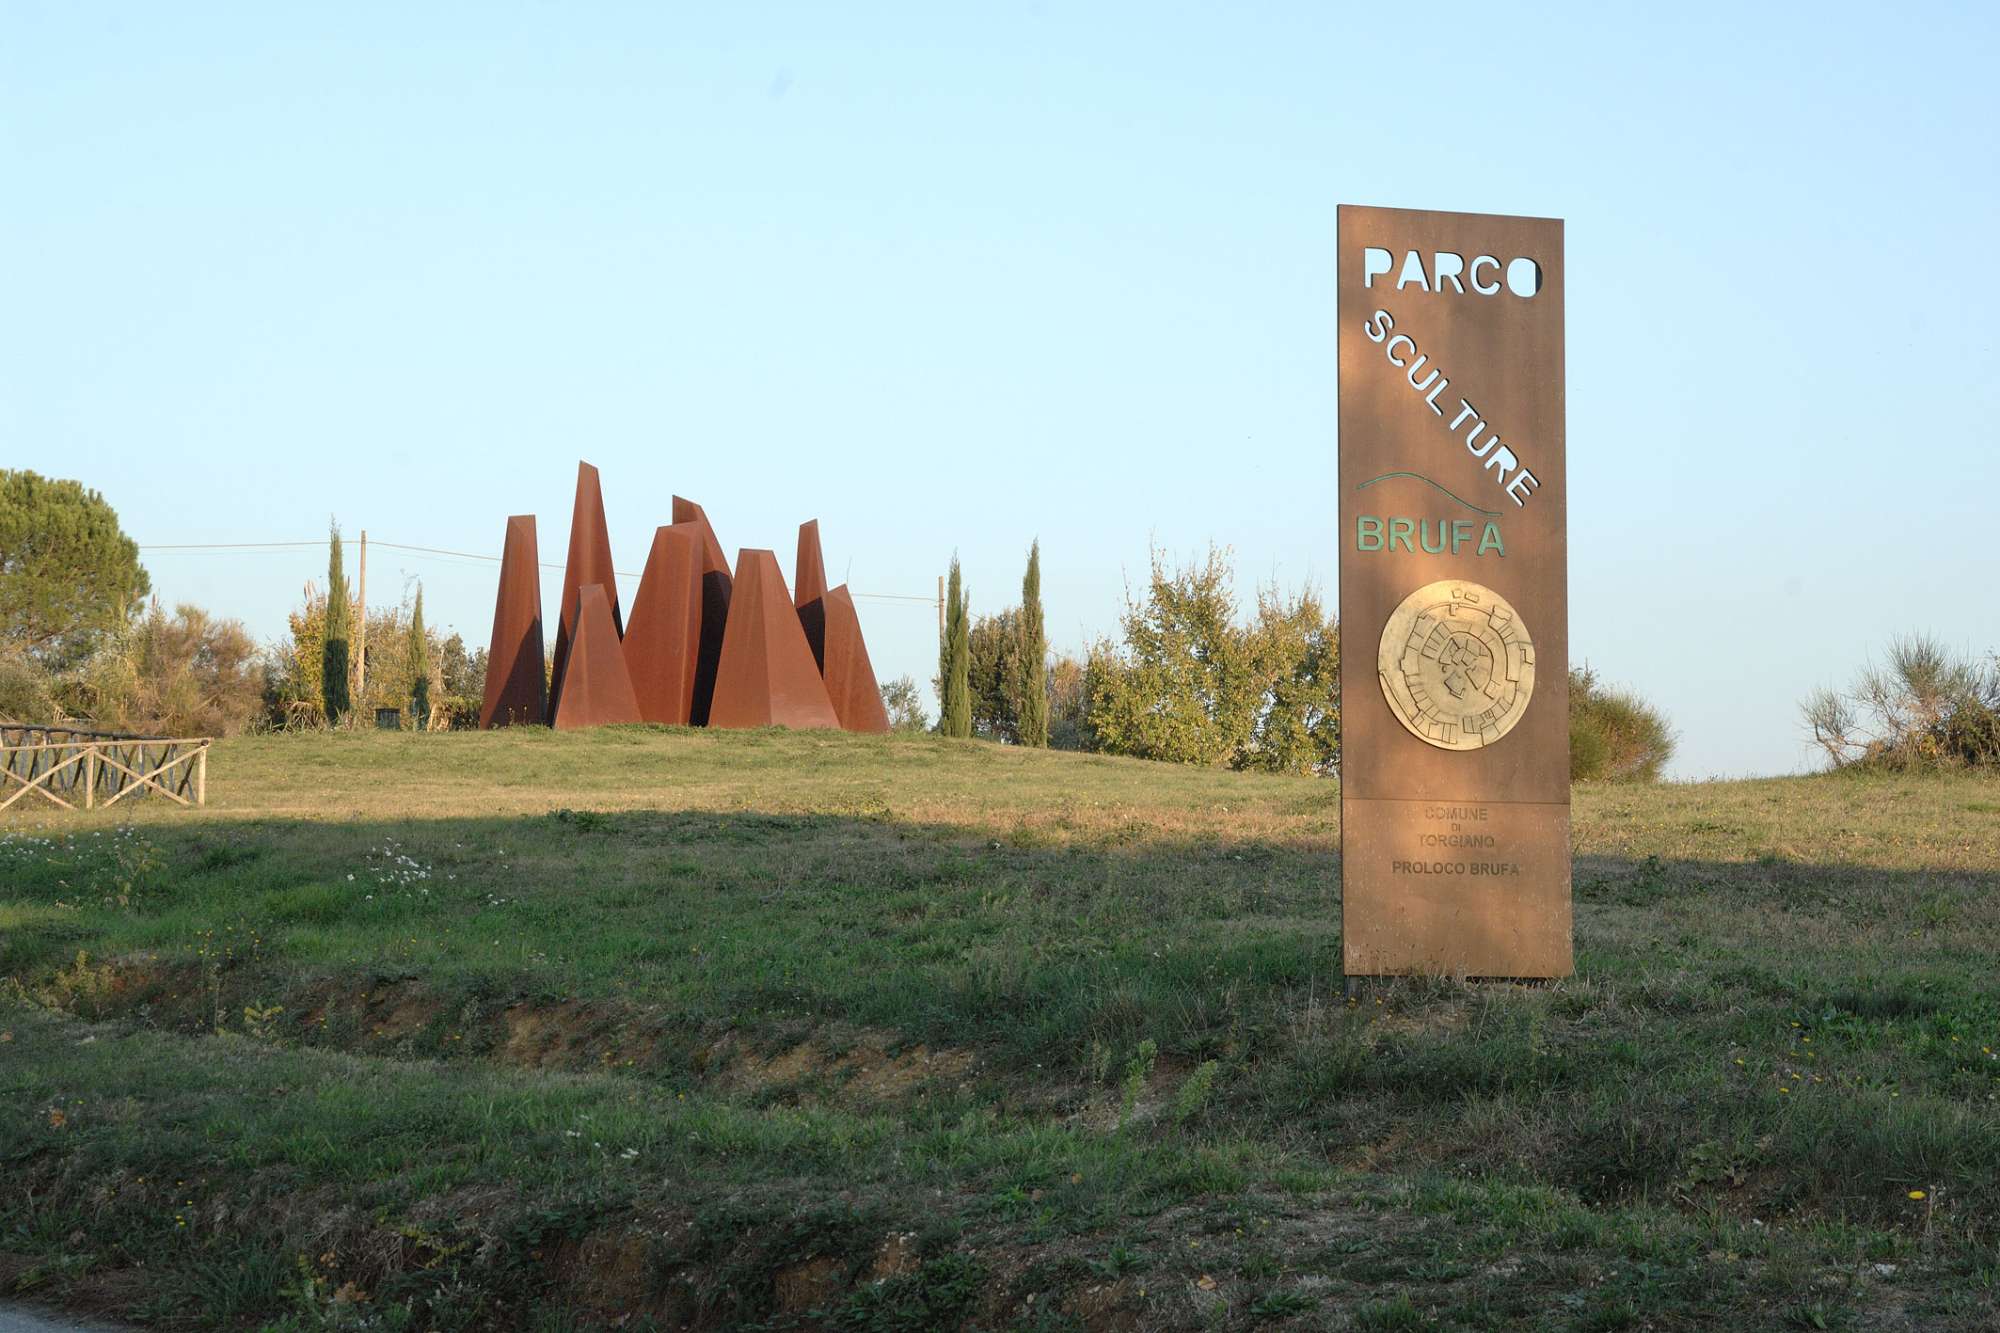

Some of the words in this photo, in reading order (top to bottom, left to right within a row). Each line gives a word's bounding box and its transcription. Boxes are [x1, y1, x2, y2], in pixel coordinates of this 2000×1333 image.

[1364, 247, 1543, 298] PARCO
[1364, 309, 1541, 507] SCULTURE
[1356, 514, 1505, 557] BRUFA
[1425, 807, 1488, 820] COMUNE
[1451, 823, 1461, 832] DI
[1418, 834, 1495, 848] TORGIANO
[1392, 861, 1465, 875] PROLOCO
[1470, 863, 1520, 876] BRUFA
